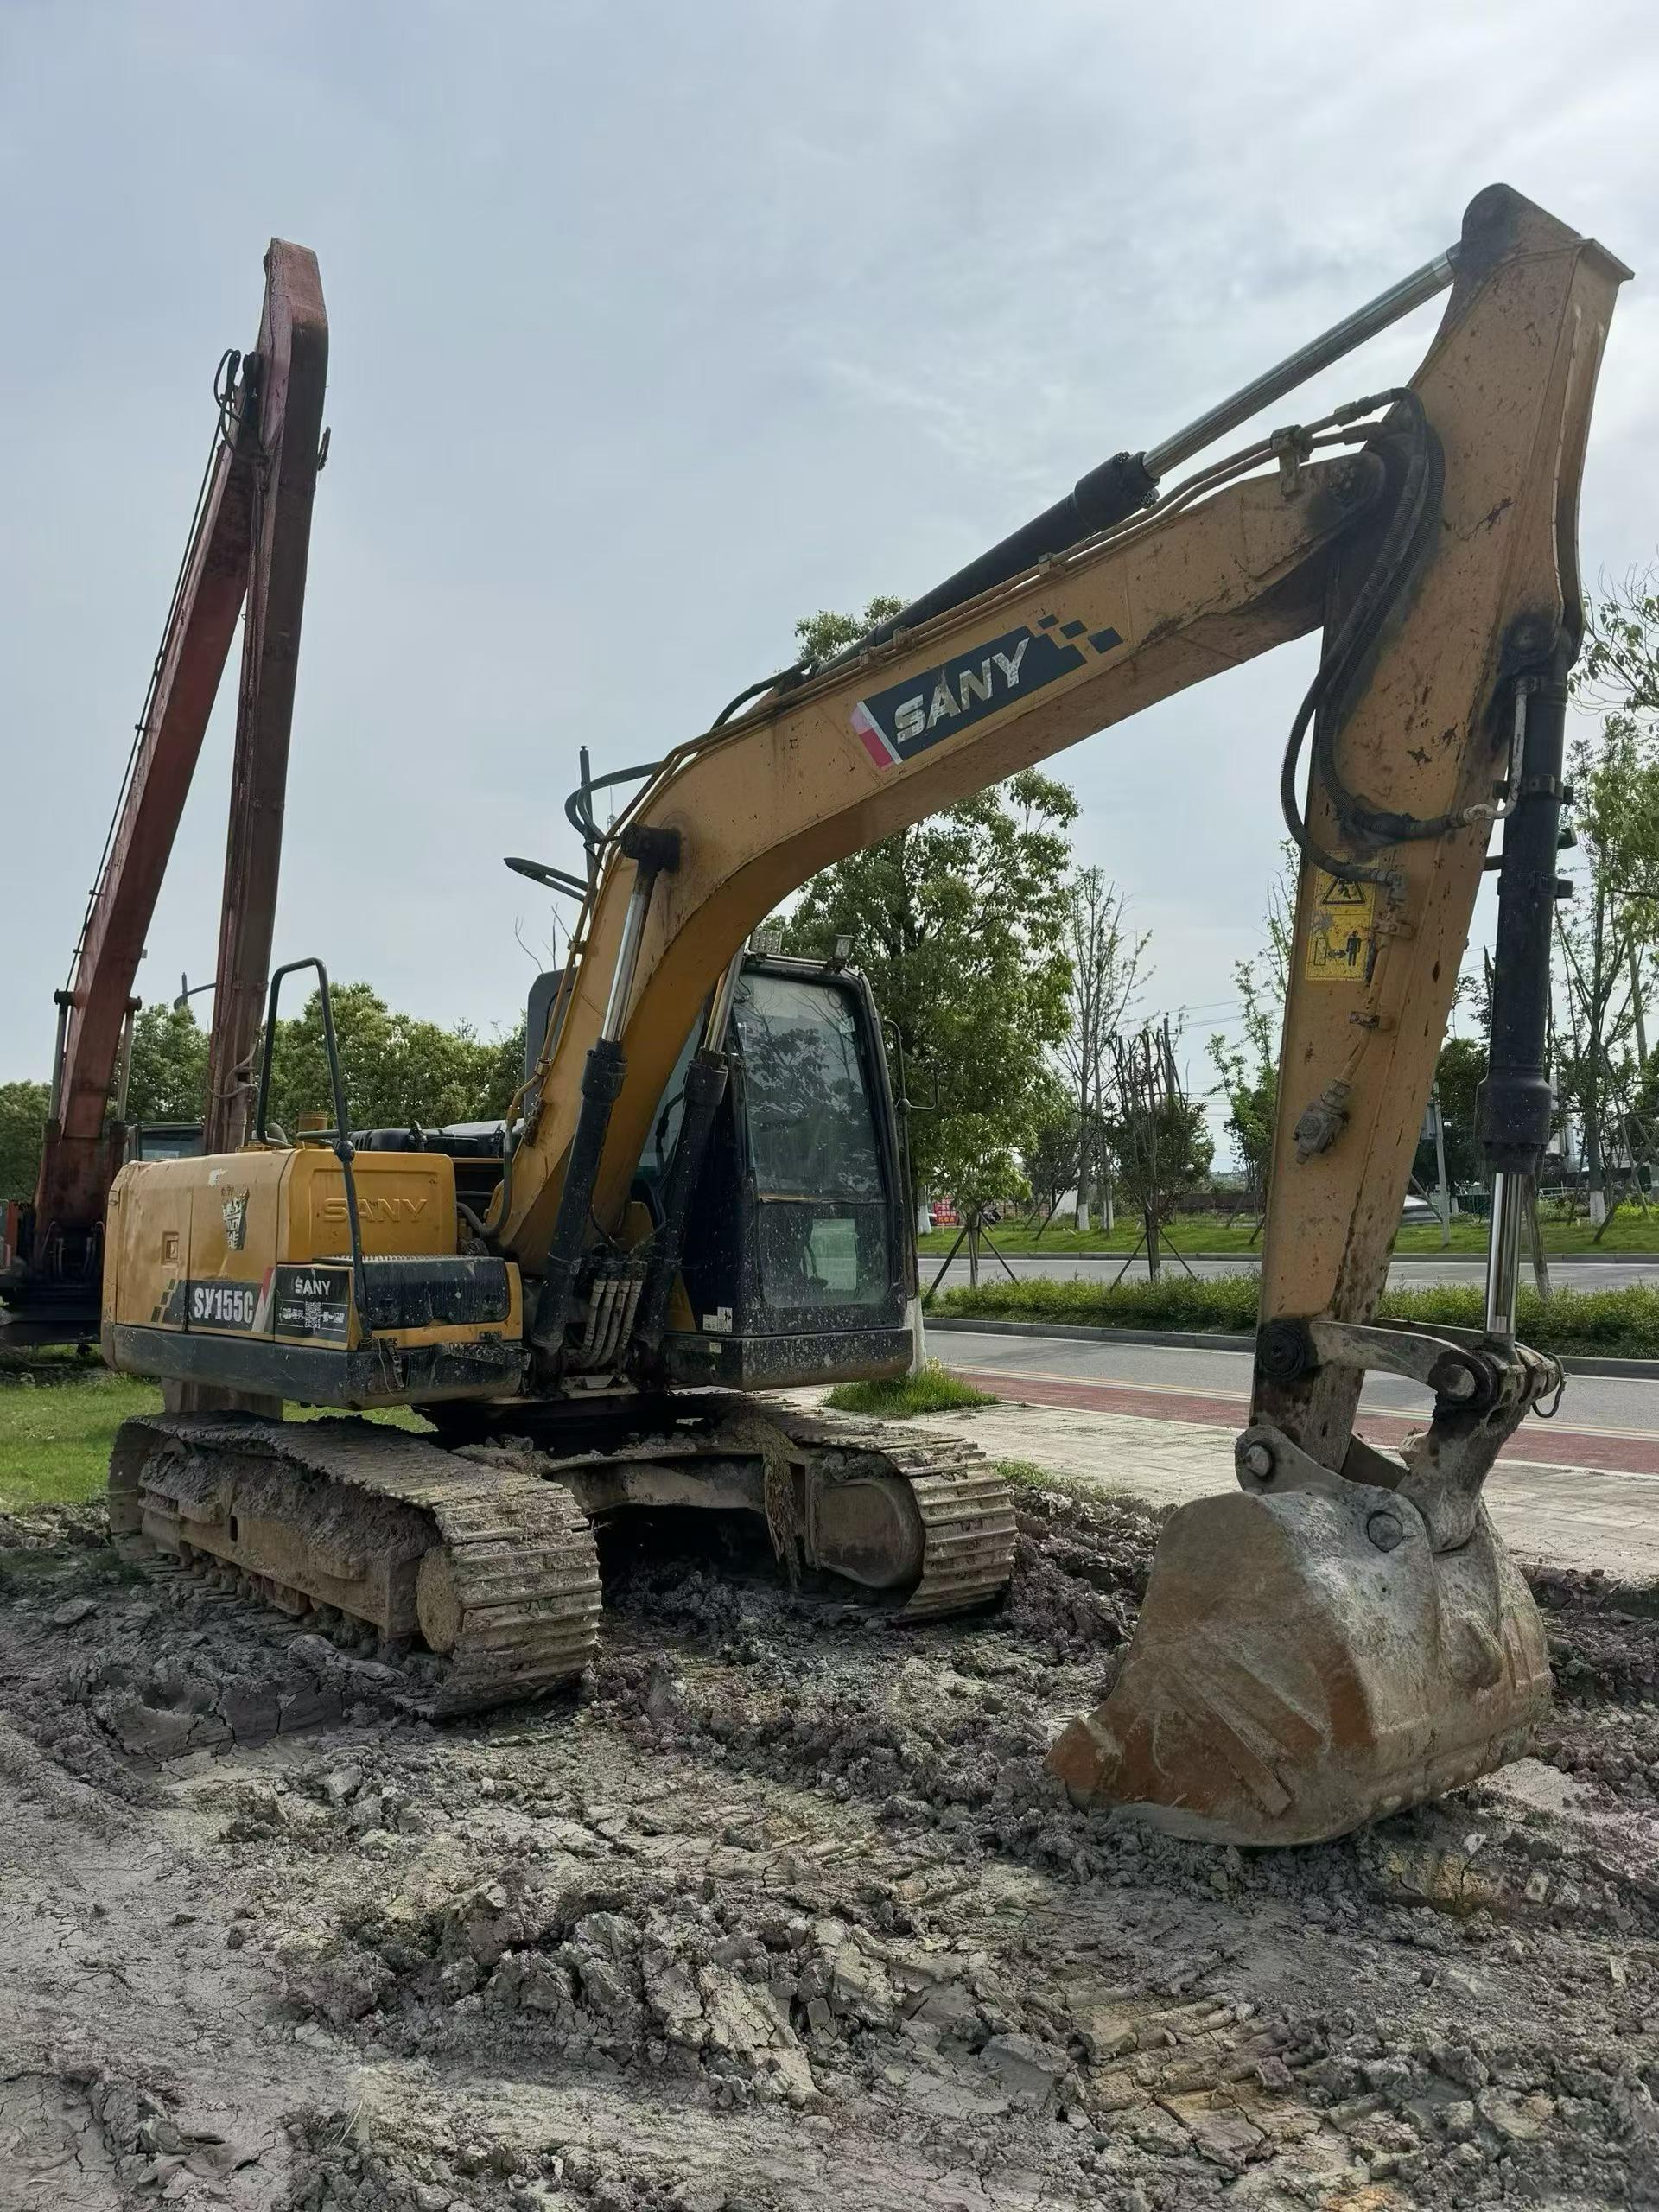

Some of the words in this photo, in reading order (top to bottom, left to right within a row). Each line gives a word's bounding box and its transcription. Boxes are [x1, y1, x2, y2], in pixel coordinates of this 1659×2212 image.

[894, 637, 1030, 744] SANY
[324, 1198, 428, 1223] SANY
[295, 1278, 331, 1295] SANY
[194, 1287, 254, 1324] SY155C
